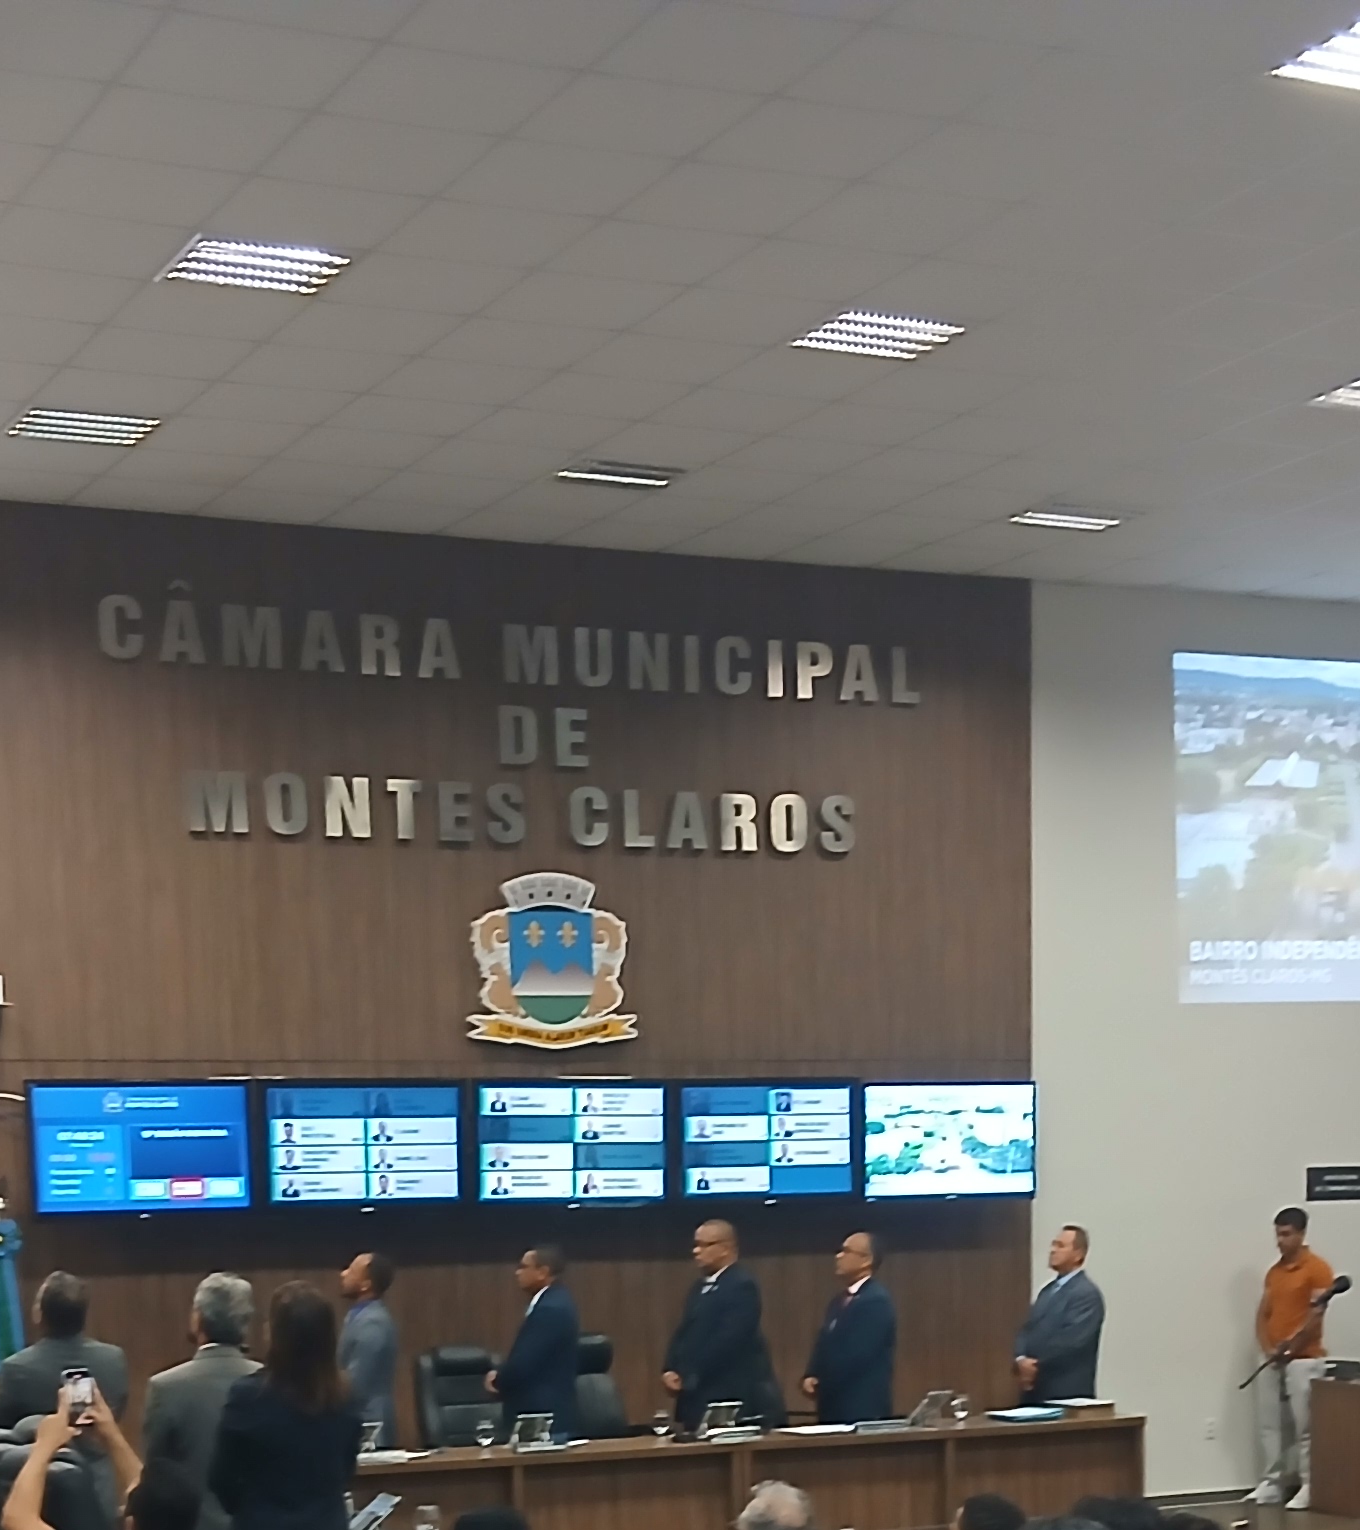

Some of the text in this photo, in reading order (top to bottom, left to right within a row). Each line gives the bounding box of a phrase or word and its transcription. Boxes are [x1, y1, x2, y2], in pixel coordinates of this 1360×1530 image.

[97, 579, 921, 704] CÂMARA MUNICIPAL
[497, 704, 590, 768] DE
[189, 769, 856, 853] MONTES CLAROS
[1189, 939, 1259, 962] BAIRRO
